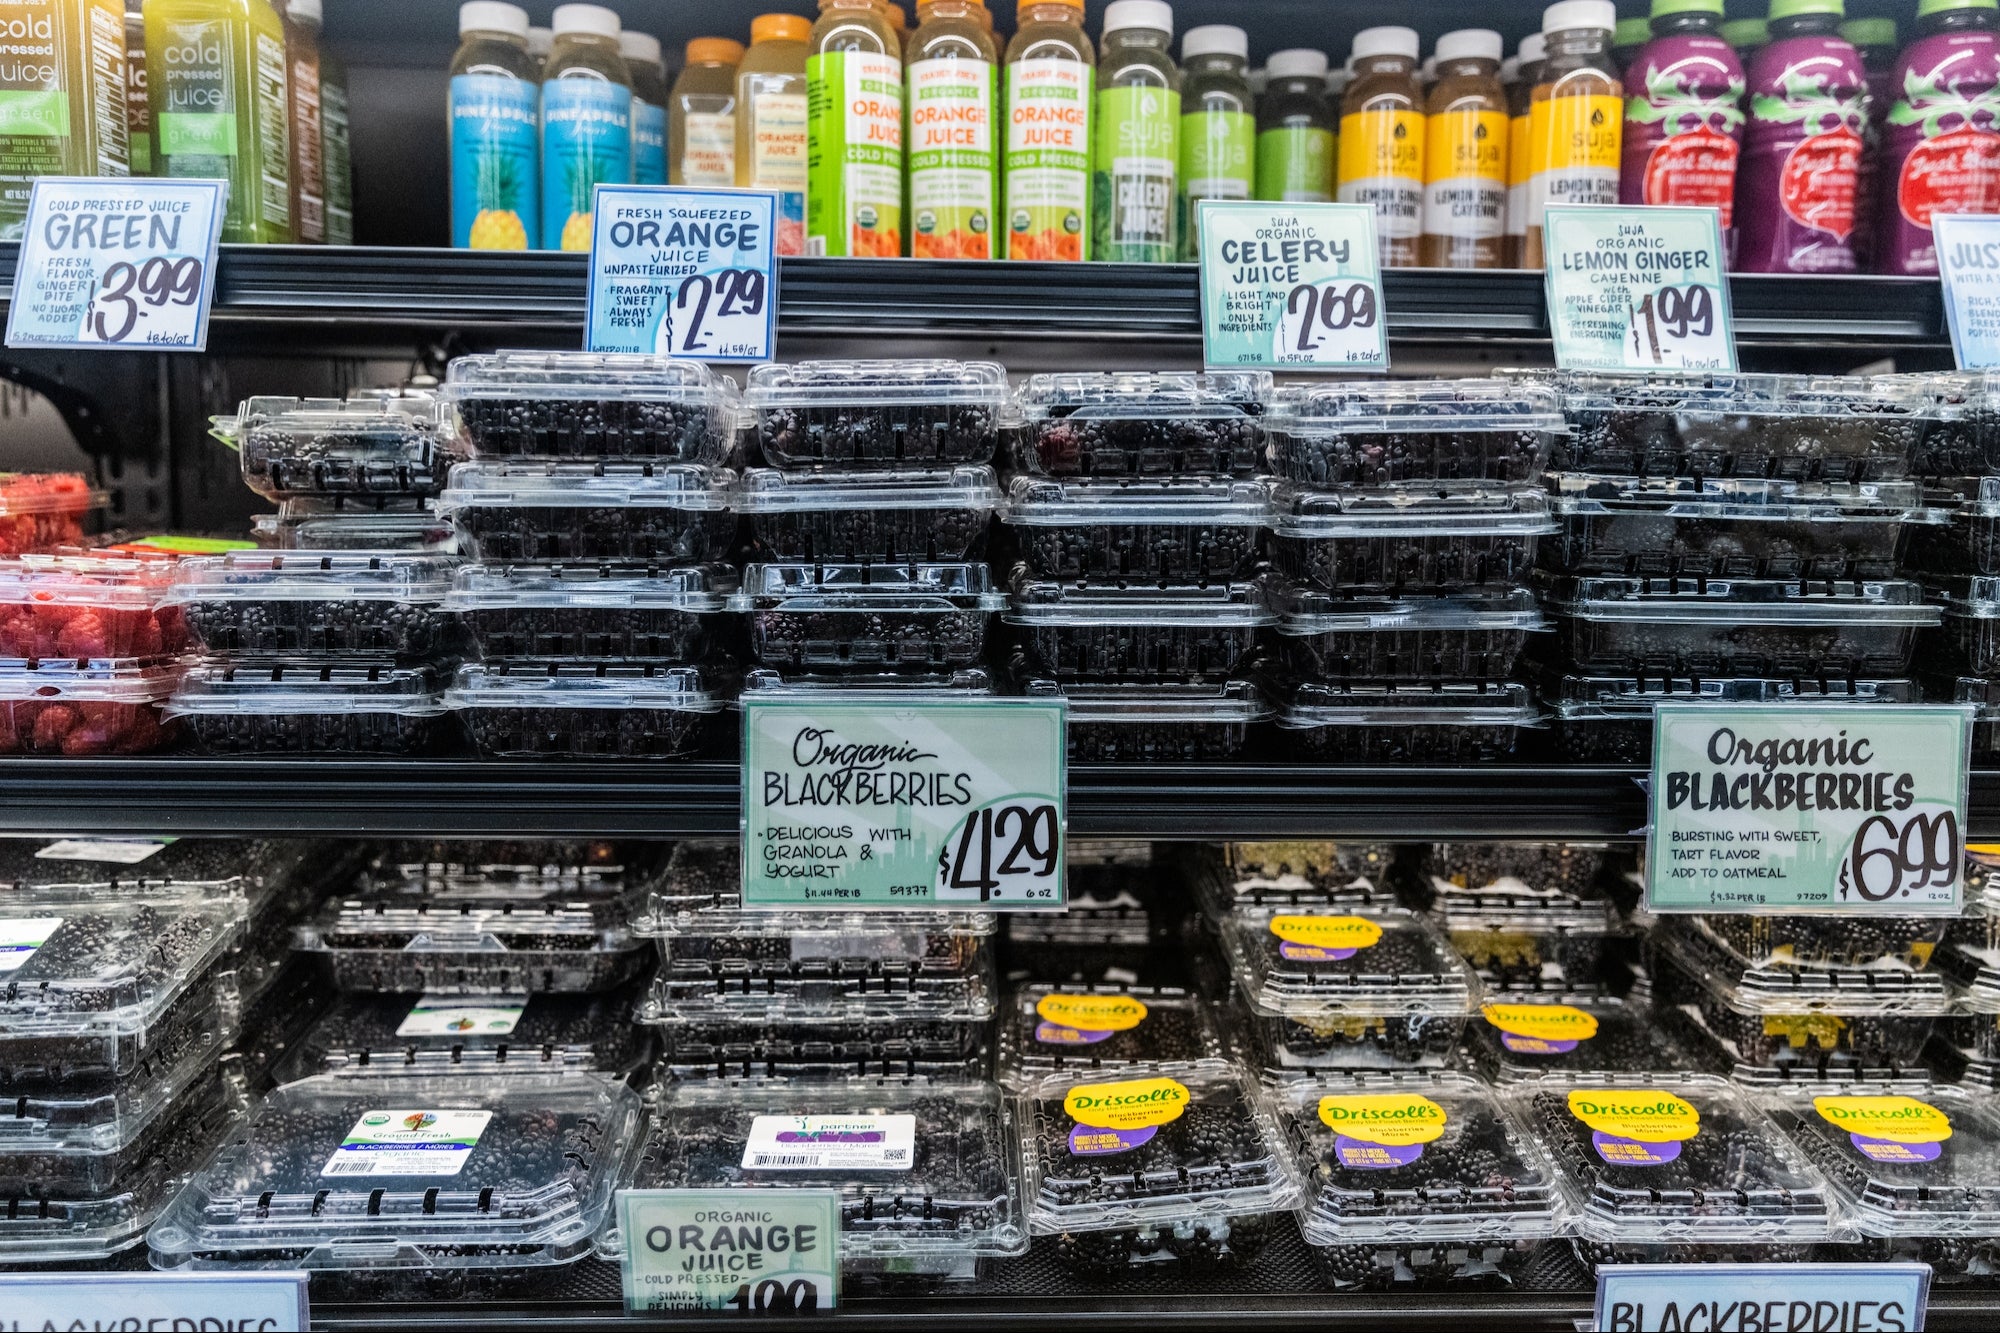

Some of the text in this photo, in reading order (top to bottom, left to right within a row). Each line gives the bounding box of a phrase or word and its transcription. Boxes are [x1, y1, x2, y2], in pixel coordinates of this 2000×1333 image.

[0, 13, 52, 38] cold
[0, 43, 54, 56] ressed
[164, 41, 221, 64] cold
[1, 60, 54, 82] uice
[166, 68, 222, 81] pressed
[167, 84, 225, 110] juice
[913, 107, 987, 124] ORANGE
[1013, 107, 1085, 125] ORANGE
[925, 128, 976, 145] JUICE
[1023, 129, 1073, 145] JUICE
[1118, 120, 1173, 149] suja
[1572, 131, 1615, 151] suja
[847, 149, 880, 161] COLD
[912, 154, 939, 168] COLD
[1009, 154, 1035, 167] COLD
[1550, 178, 1593, 196] LEMON
[49, 200, 191, 212] COLD PRESSED JUICE
[617, 208, 752, 220] FRESH SQUEEZED
[1271, 218, 1299, 227] SUJA
[44, 213, 181, 250] GREEN
[610, 221, 760, 251] ORANGE
[1256, 227, 1317, 239] ORGANIC
[1618, 225, 1644, 236] SUJA
[1596, 238, 1664, 249] ORGANIC
[651, 250, 709, 263] JUICE
[1221, 239, 1350, 264] CELERY
[1949, 242, 2000, 269] JUS
[48, 258, 91, 267] FRESH
[1563, 250, 1710, 271] LEMON GINGER
[604, 265, 697, 275] UNPASTEURIZED
[1232, 265, 1299, 284] JUICE
[1590, 273, 1662, 284] CAYENNE
[1955, 274, 1993, 283] WITH A
[37, 281, 87, 291] GINGER
[44, 292, 73, 301] BITE
[616, 296, 657, 306] SWEET
[1228, 291, 1286, 300] LIGHT AND
[1565, 295, 1632, 304] APPLE CIDER
[50, 304, 82, 312] SUGAR
[1226, 301, 1272, 310] BRIGHT
[1576, 304, 1623, 313] VINEGAR
[38, 314, 78, 322] ADDED
[609, 308, 652, 318] ALWAYS
[1228, 313, 1265, 323] ONLY 2
[611, 318, 645, 328] FRESH
[1218, 323, 1272, 332] INGREDIENTS
[1571, 320, 1625, 330] REFRESHING
[1570, 330, 1621, 339] ENERGIZING
[1707, 727, 1874, 773] Organic
[793, 727, 938, 786] Organic
[764, 771, 972, 807] BLACKBERRIES
[1666, 771, 1915, 812] BLACKBERRIES
[767, 826, 911, 841] DELICIOUS WITH
[1672, 831, 1822, 844] BURSTING WITH SWEET,
[764, 845, 873, 860] GRANOLA &
[1671, 849, 1760, 860] TART FLAVOR
[764, 865, 840, 879] YOGURT
[1672, 868, 1787, 879] ADD TO OATMEAL
[805, 888, 849, 898] $11.44 PER
[890, 886, 928, 896] 59377
[1026, 889, 1051, 898] 6 OZ
[1796, 892, 1828, 901] 97209
[1710, 891, 1753, 904] $9.32 PER
[1278, 922, 1373, 934] Driscoll's
[1048, 1002, 1139, 1015] Driscoll's
[1072, 1088, 1181, 1109] Driscoll's
[1327, 1105, 1438, 1120] Driscoll's
[1576, 1102, 1689, 1115] Driscoll's
[1825, 1107, 1937, 1118] Driscoll's
[695, 1211, 773, 1223] ORGANIC
[646, 1225, 817, 1252] ORANGE
[682, 1253, 763, 1273] JUICE
[645, 1274, 739, 1284] COLD PRESSED
[658, 1291, 703, 1301] SIMPLY
